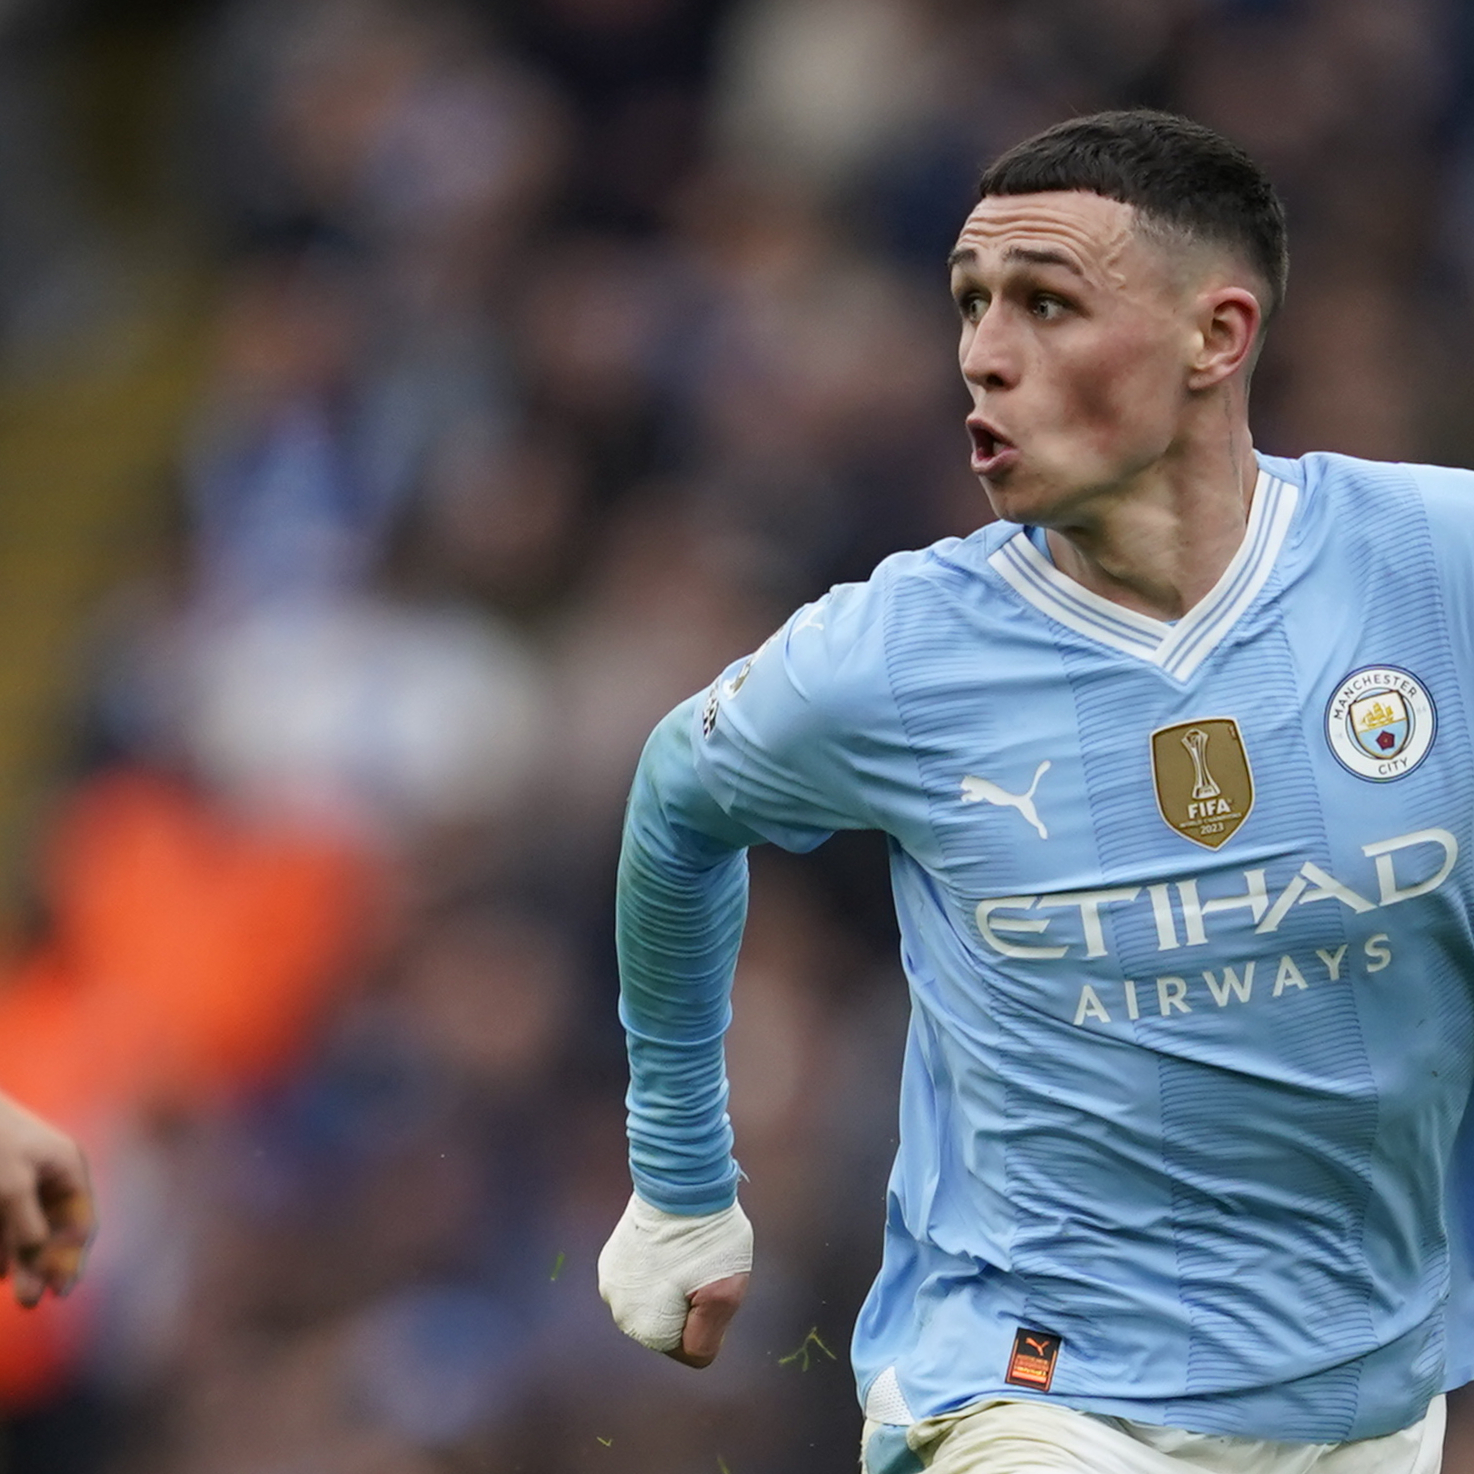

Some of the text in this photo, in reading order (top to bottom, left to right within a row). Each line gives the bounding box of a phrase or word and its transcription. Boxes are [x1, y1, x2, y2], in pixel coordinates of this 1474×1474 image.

[1333, 673, 1418, 720] MANCHESTER
[1378, 757, 1408, 775] CITY
[1187, 798, 1232, 819] FIFA
[1200, 822, 1225, 836] 2023
[974, 828, 1459, 960] ETIHAD
[1073, 932, 1394, 1026] AIRWAYS
